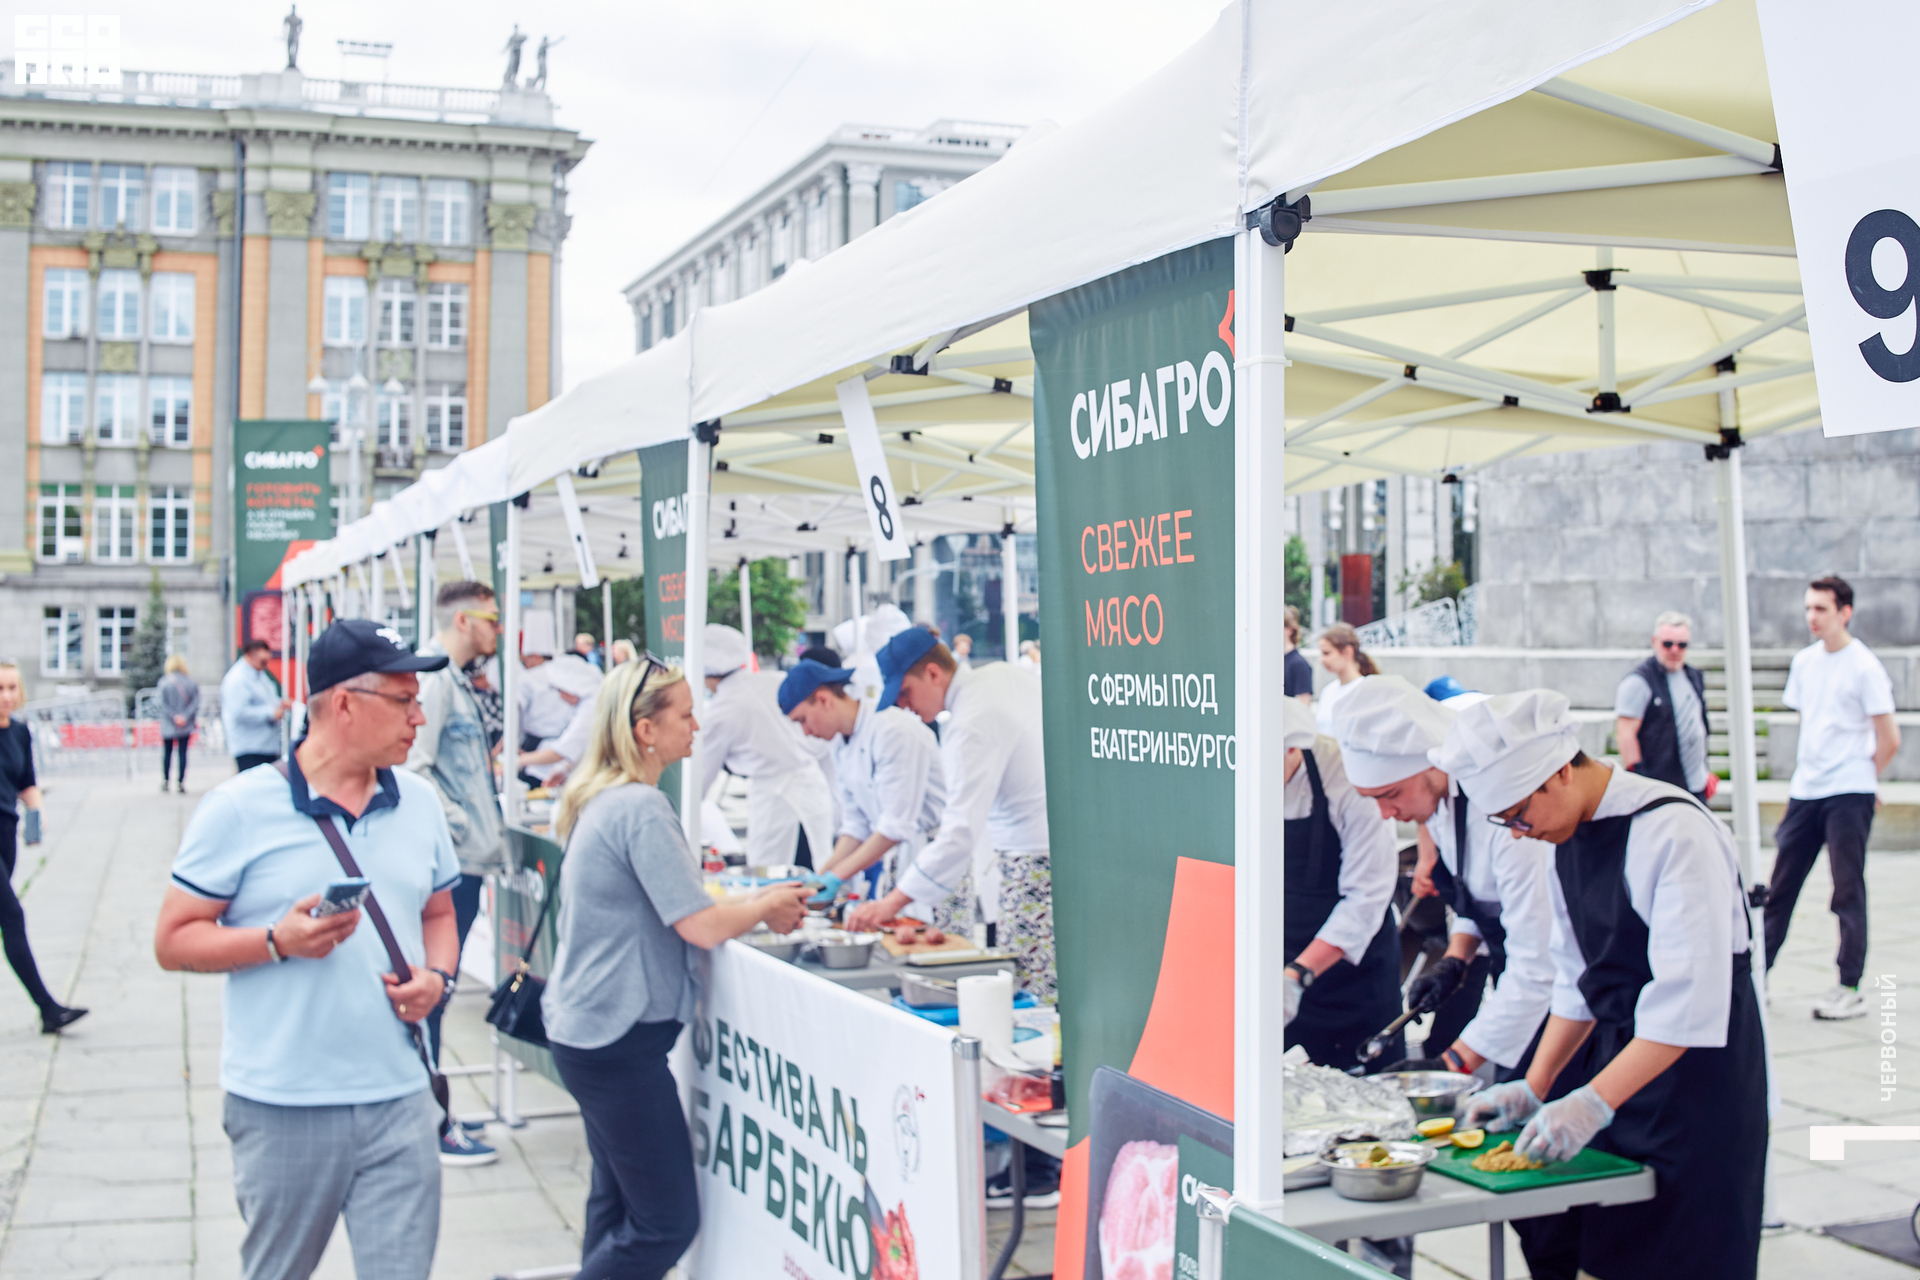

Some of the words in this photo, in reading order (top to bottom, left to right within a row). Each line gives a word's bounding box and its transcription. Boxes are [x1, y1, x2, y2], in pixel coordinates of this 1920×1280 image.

[1845, 208, 1920, 383] 9
[1070, 350, 1232, 460] СИБАГРО
[653, 493, 687, 540] СИБА
[870, 475, 893, 541] 8
[1081, 509, 1195, 574] СВЕЖЕЕ
[1085, 593, 1164, 647] МЯСО
[1088, 673, 1099, 705] С
[1101, 673, 1168, 707] ФЕРМЫ
[1172, 673, 1218, 715] ПОД
[1091, 727, 1235, 770] ЕКАТЕРИНБУРГО
[690, 1016, 868, 1176] ФЕСТИВАЛЬ
[690, 1083, 874, 1280] БАРБЕКЮ
